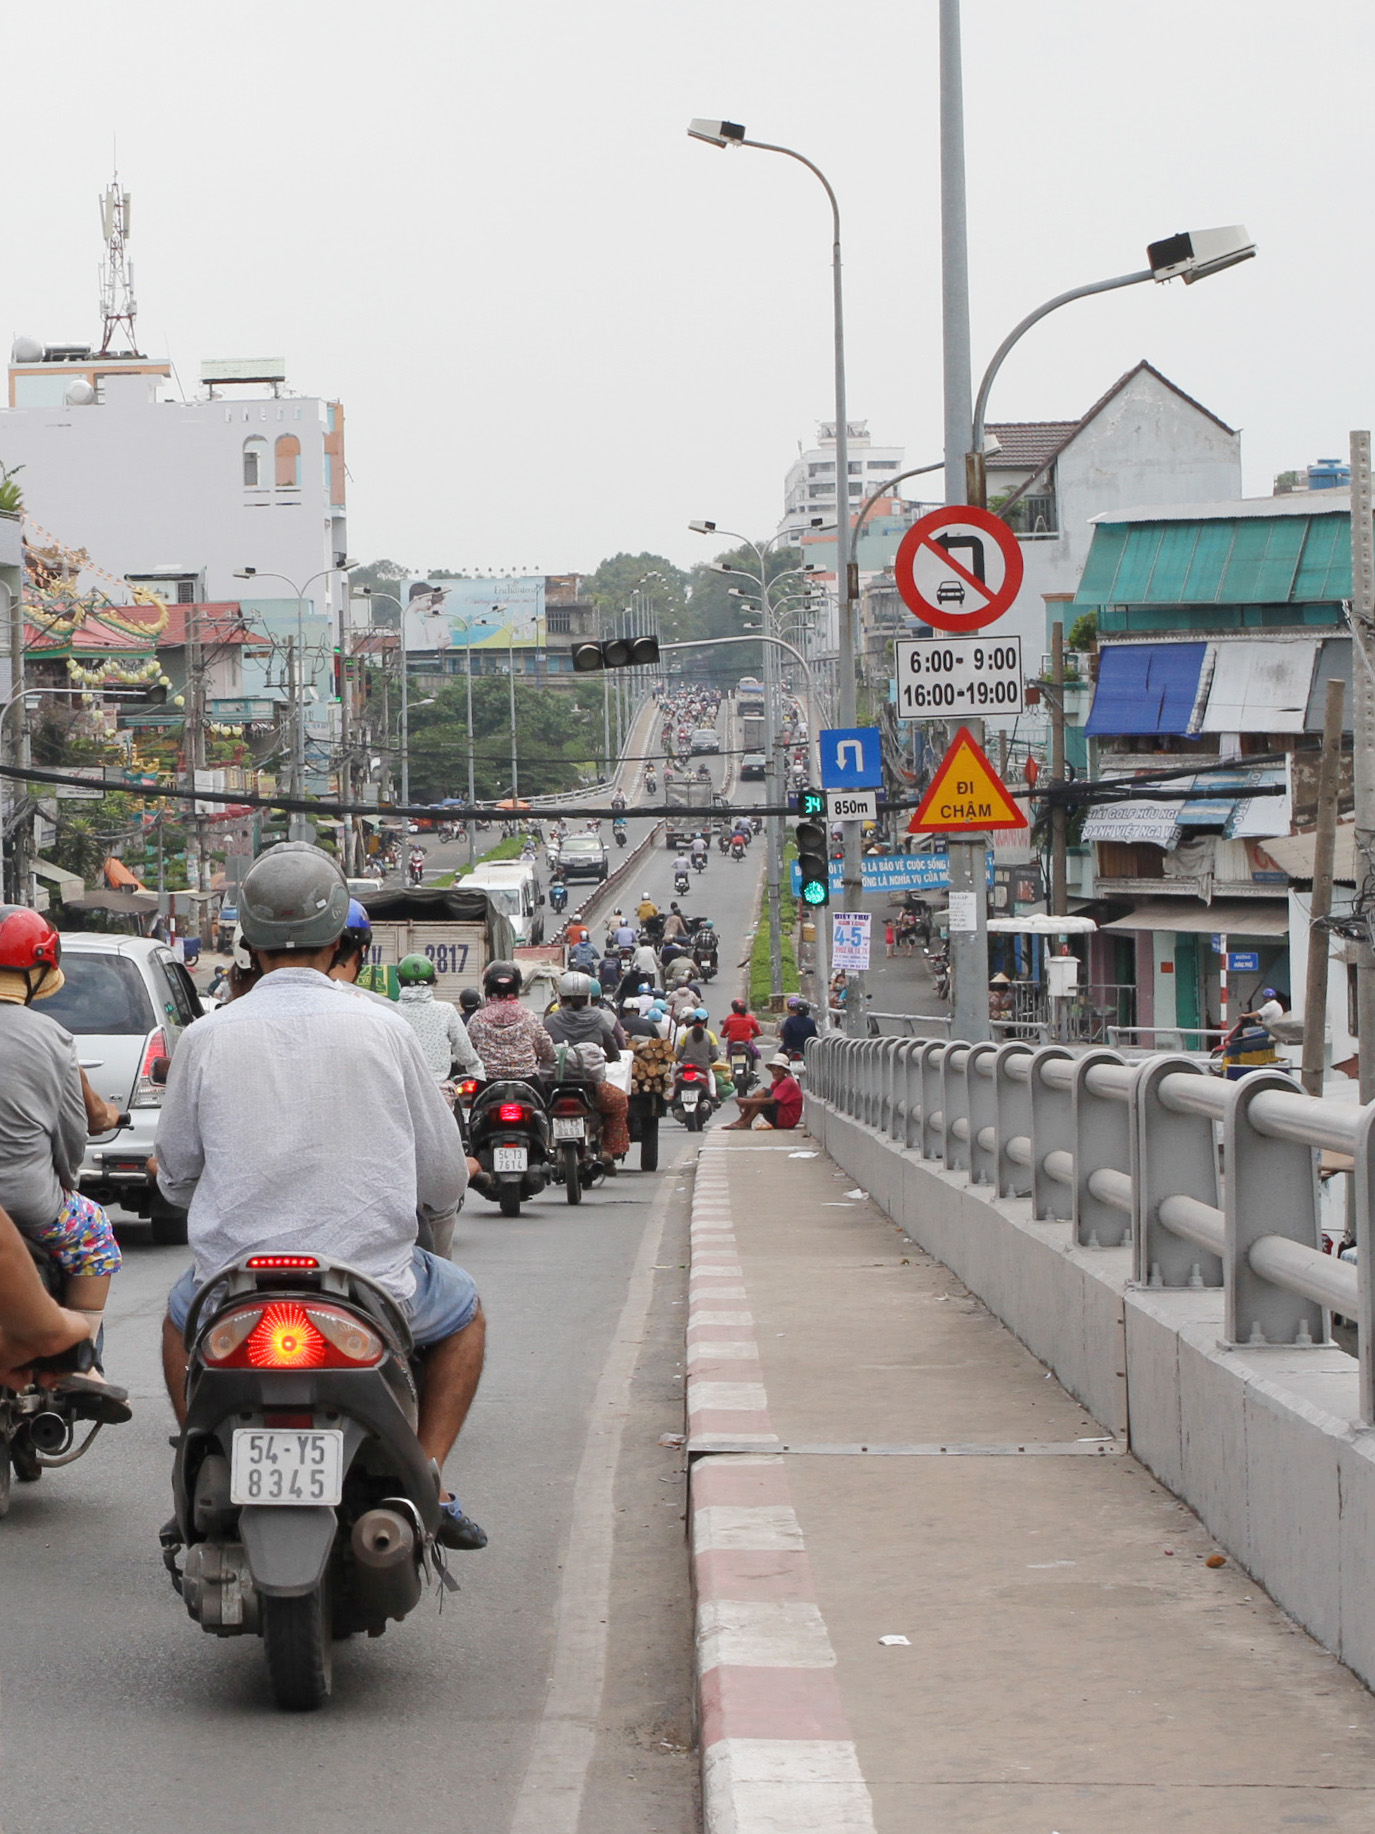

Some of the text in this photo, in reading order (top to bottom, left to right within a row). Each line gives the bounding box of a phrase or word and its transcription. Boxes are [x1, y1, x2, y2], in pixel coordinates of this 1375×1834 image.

[974, 647, 1017, 670] 9:00
[957, 781, 974, 795] ĐI
[805, 795, 821, 814] 34
[834, 800, 868, 815] 850m
[940, 801, 992, 821] CHẬM
[1108, 808, 1134, 820] GOLF
[1140, 824, 1161, 838] NGA
[868, 860, 877, 872] LÀ
[879, 858, 894, 872] BẢO
[895, 858, 905, 872] VỆ
[927, 857, 946, 870] SỐNG
[878, 873, 887, 886] LÀ
[834, 926, 862, 947] 4-5
[425, 944, 469, 973] 2817
[499, 1160, 522, 1170] 7614
[249, 1435, 325, 1465] 54-Y5
[248, 1468, 325, 1499] 8345
